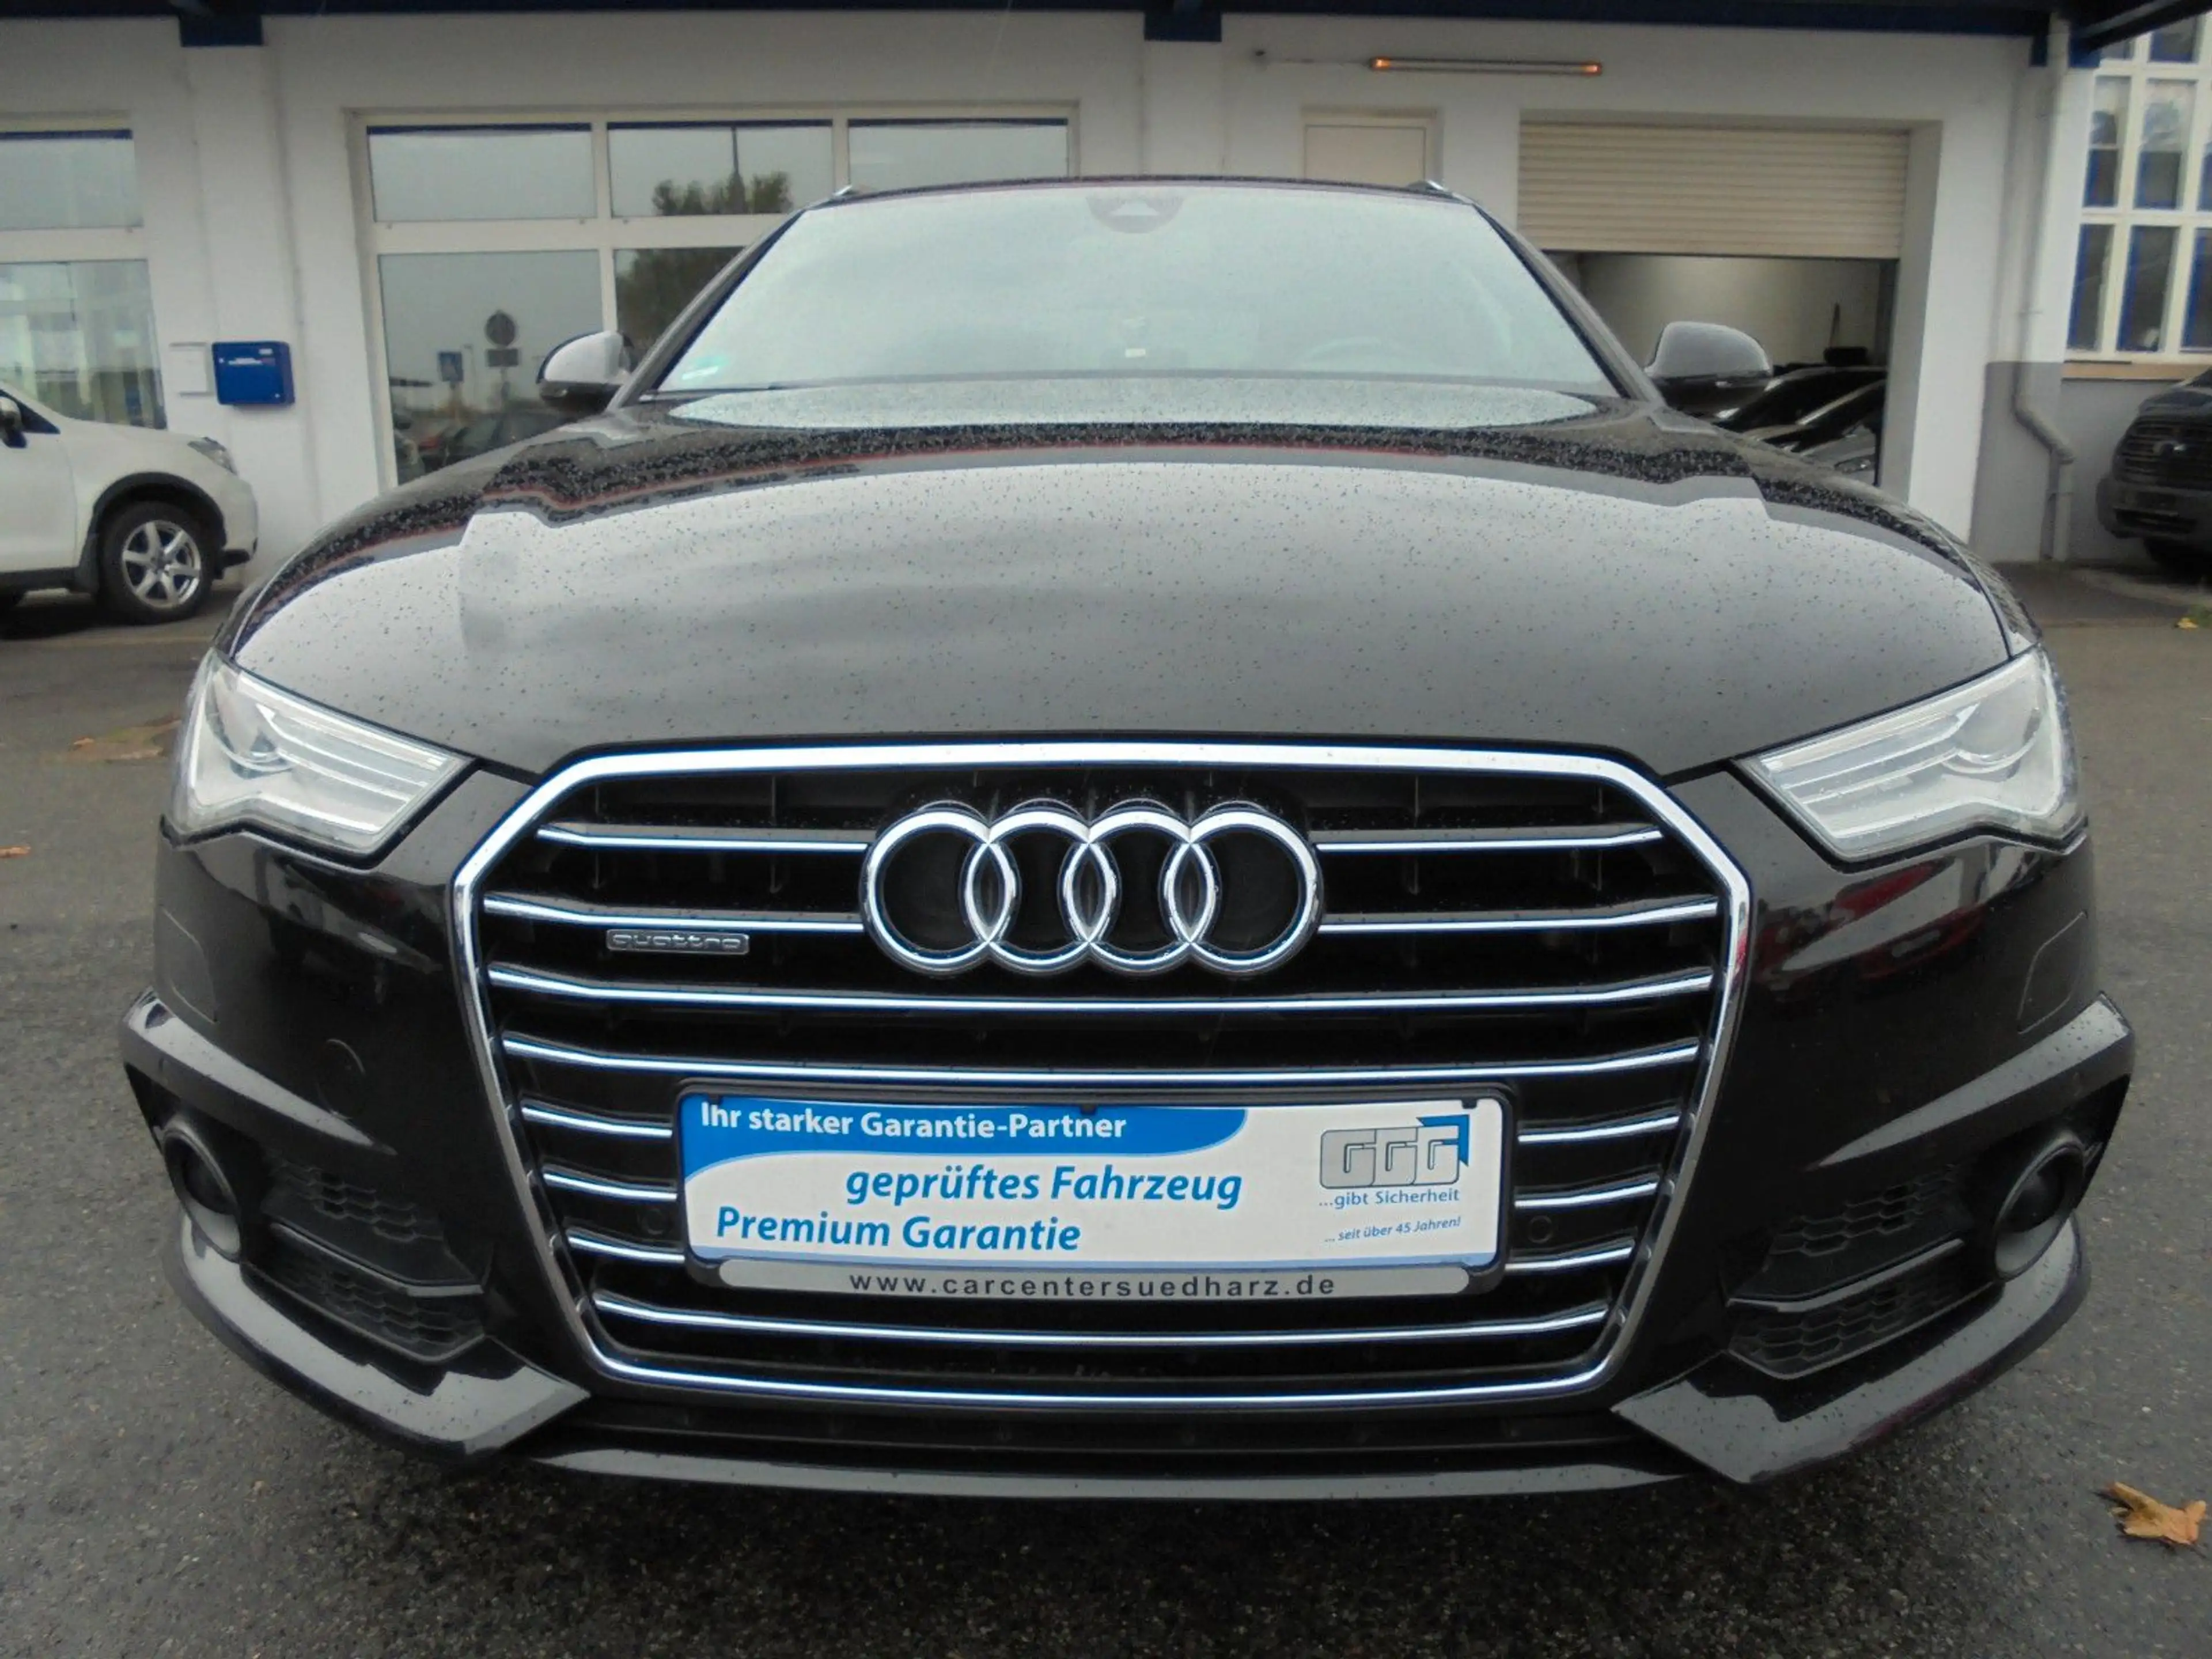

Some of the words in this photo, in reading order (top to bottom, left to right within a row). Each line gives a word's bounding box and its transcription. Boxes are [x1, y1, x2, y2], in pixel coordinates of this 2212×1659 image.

[701, 1101, 742, 1128] Ihr
[749, 1108, 853, 1135] starker
[861, 1112, 1126, 1138] Garantie-Partner
[846, 1164, 1040, 1206] geprüftes
[1051, 1164, 1243, 1210] Fahrzeug
[1376, 1188, 1460, 1206] Sicherheit
[717, 1206, 890, 1247] Premium
[903, 1215, 1081, 1251] Garantie
[1338, 1228, 1361, 1241] seit
[1363, 1225, 1393, 1238] über
[1396, 1222, 1411, 1234] 45
[1414, 1216, 1462, 1232] Jahren!
[850, 1274, 1335, 1296] www.carcentersuedharz.de
